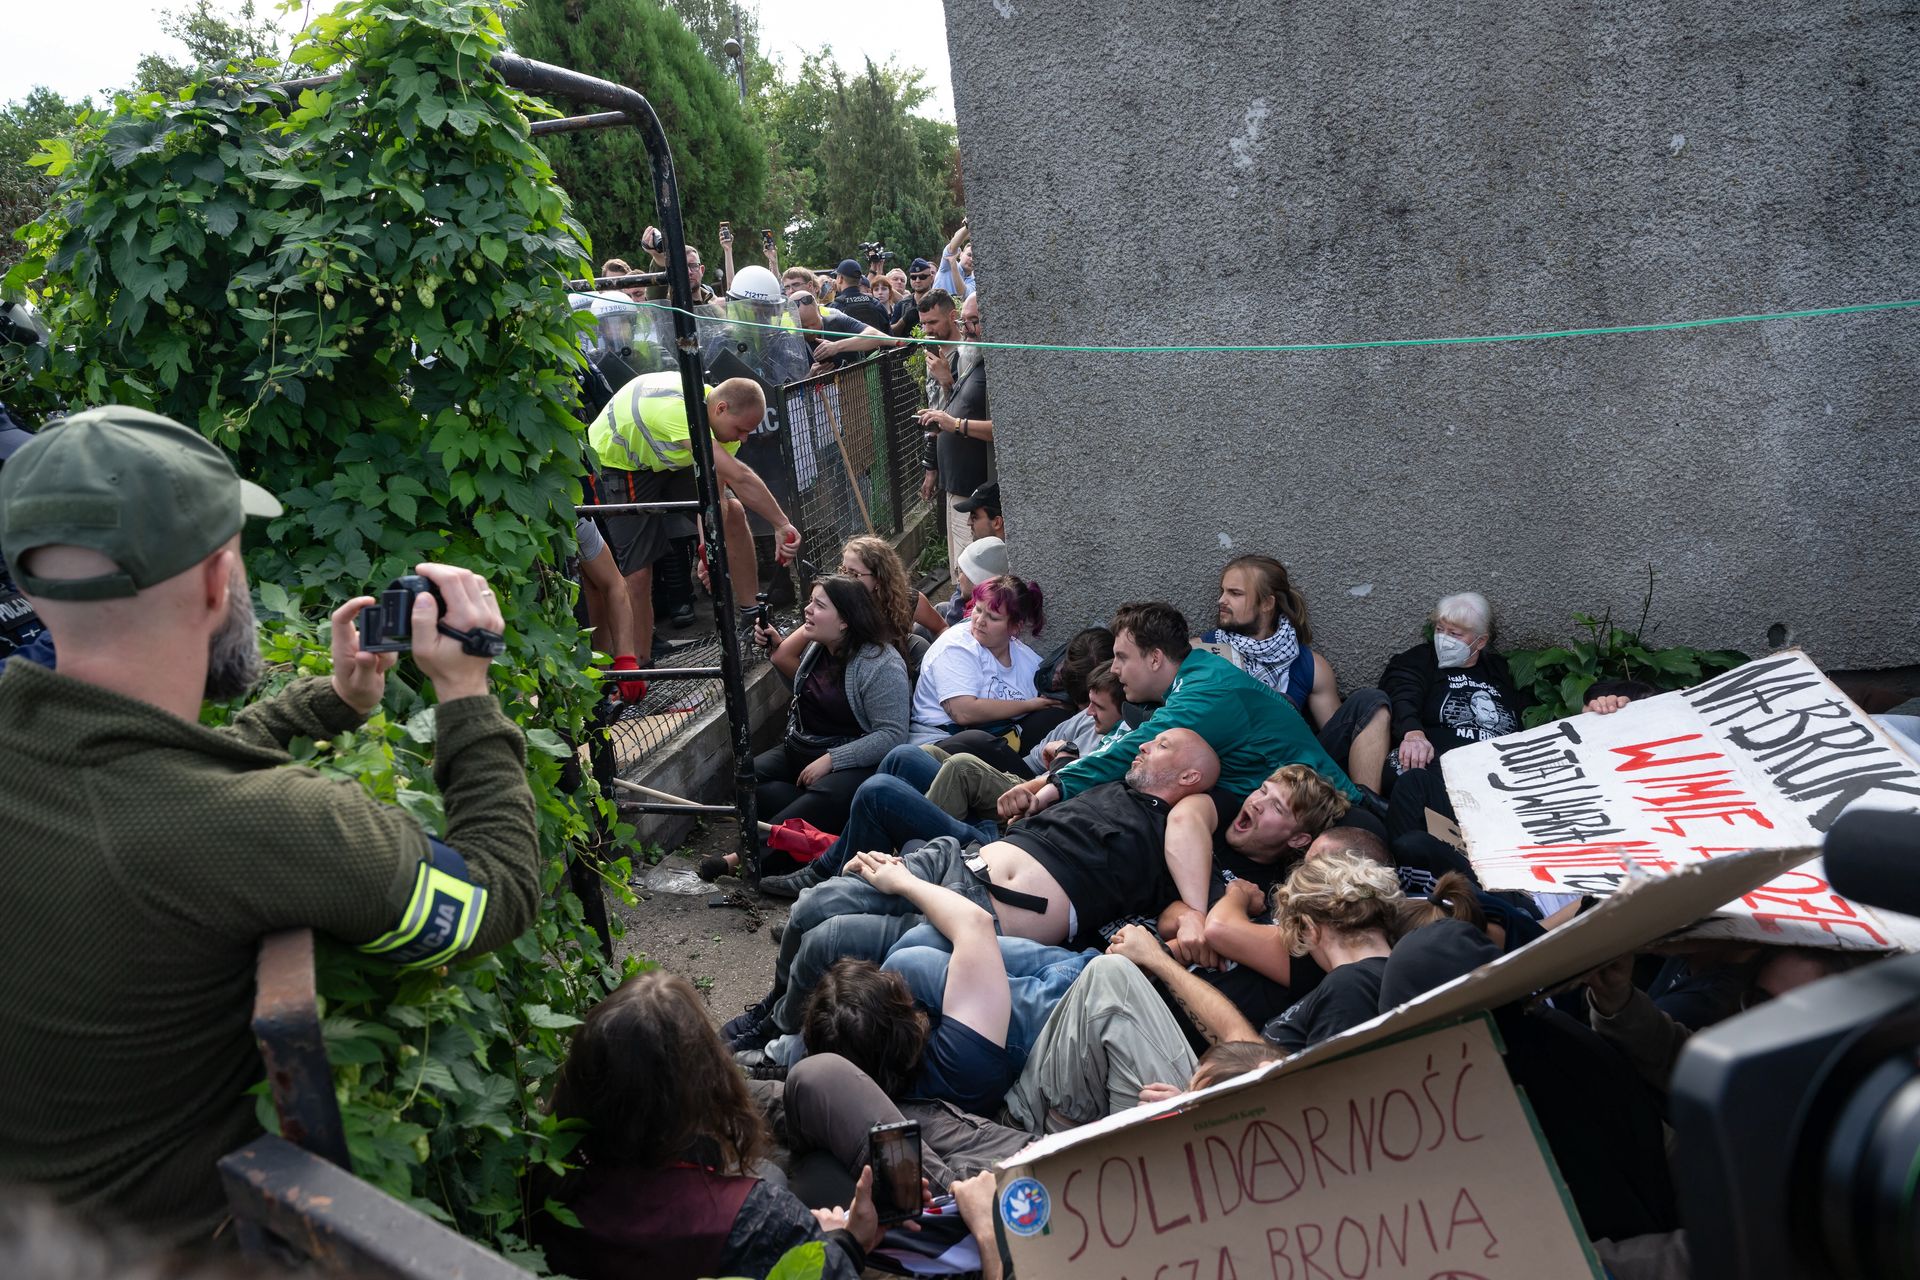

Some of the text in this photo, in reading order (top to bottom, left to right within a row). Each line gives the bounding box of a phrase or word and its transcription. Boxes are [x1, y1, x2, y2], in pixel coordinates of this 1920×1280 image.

[1456, 728, 1475, 740] NA
[1487, 721, 1587, 792] TUTAJ
[1679, 656, 1920, 834] NA BRUK
[1062, 1042, 1485, 1263] SOLIDARNOŚĆ
[1266, 1187, 1499, 1280] BRONIĄ
